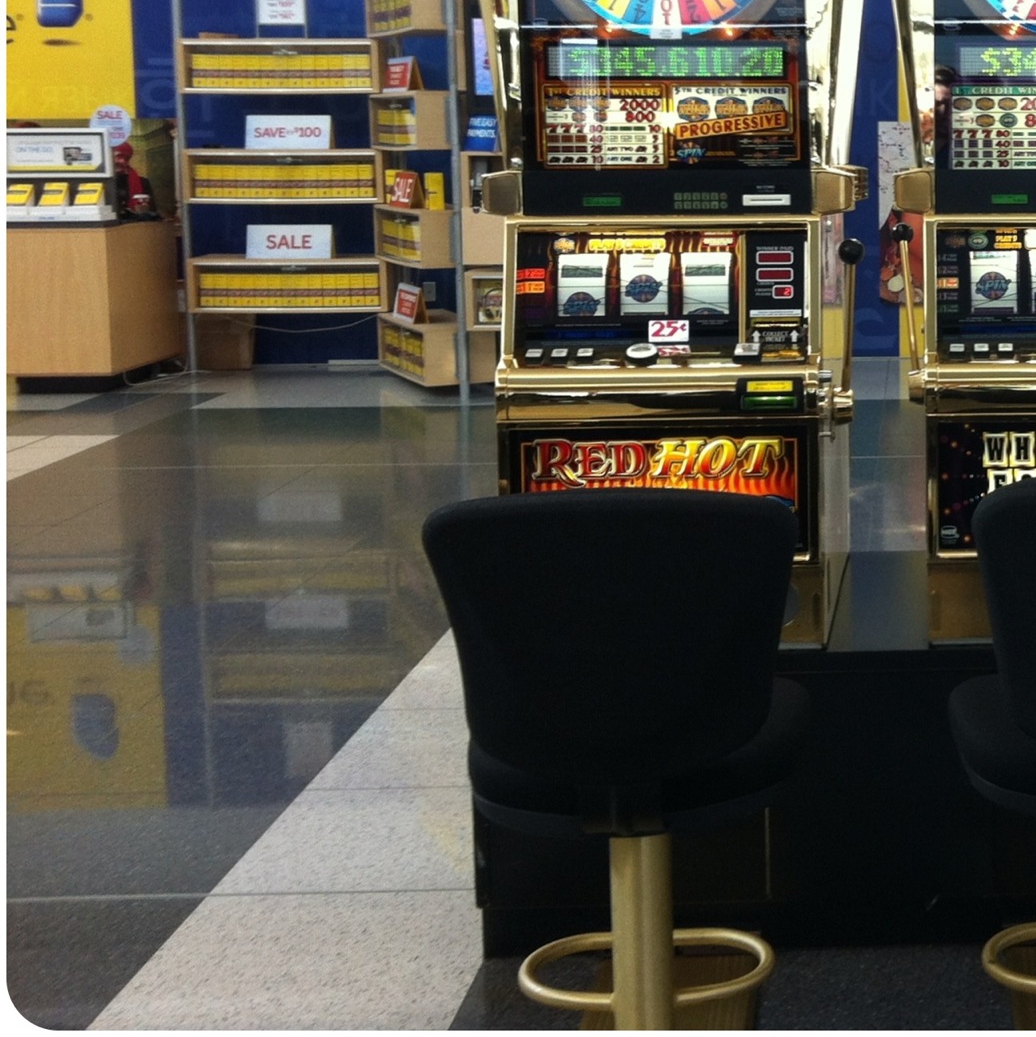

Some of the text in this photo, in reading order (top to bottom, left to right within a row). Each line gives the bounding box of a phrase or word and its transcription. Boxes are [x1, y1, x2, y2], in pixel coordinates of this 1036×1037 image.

[611, 87, 661, 96] WINNERS
[696, 86, 736, 95] CREDIT
[738, 86, 788, 95] WINNERS
[972, 86, 1014, 96] CREDIT
[619, 98, 661, 111] 2000
[97, 109, 123, 120] SALE
[625, 110, 656, 123] 800
[679, 112, 784, 139] PROGRESSIVE
[253, 126, 286, 139] SAVE
[652, 155, 660, 164] 2
[391, 177, 414, 203] SALE
[265, 234, 313, 250] SALE
[975, 278, 1012, 294] SPIN
[650, 320, 688, 338] 25¢
[531, 436, 783, 489] RED HOT
